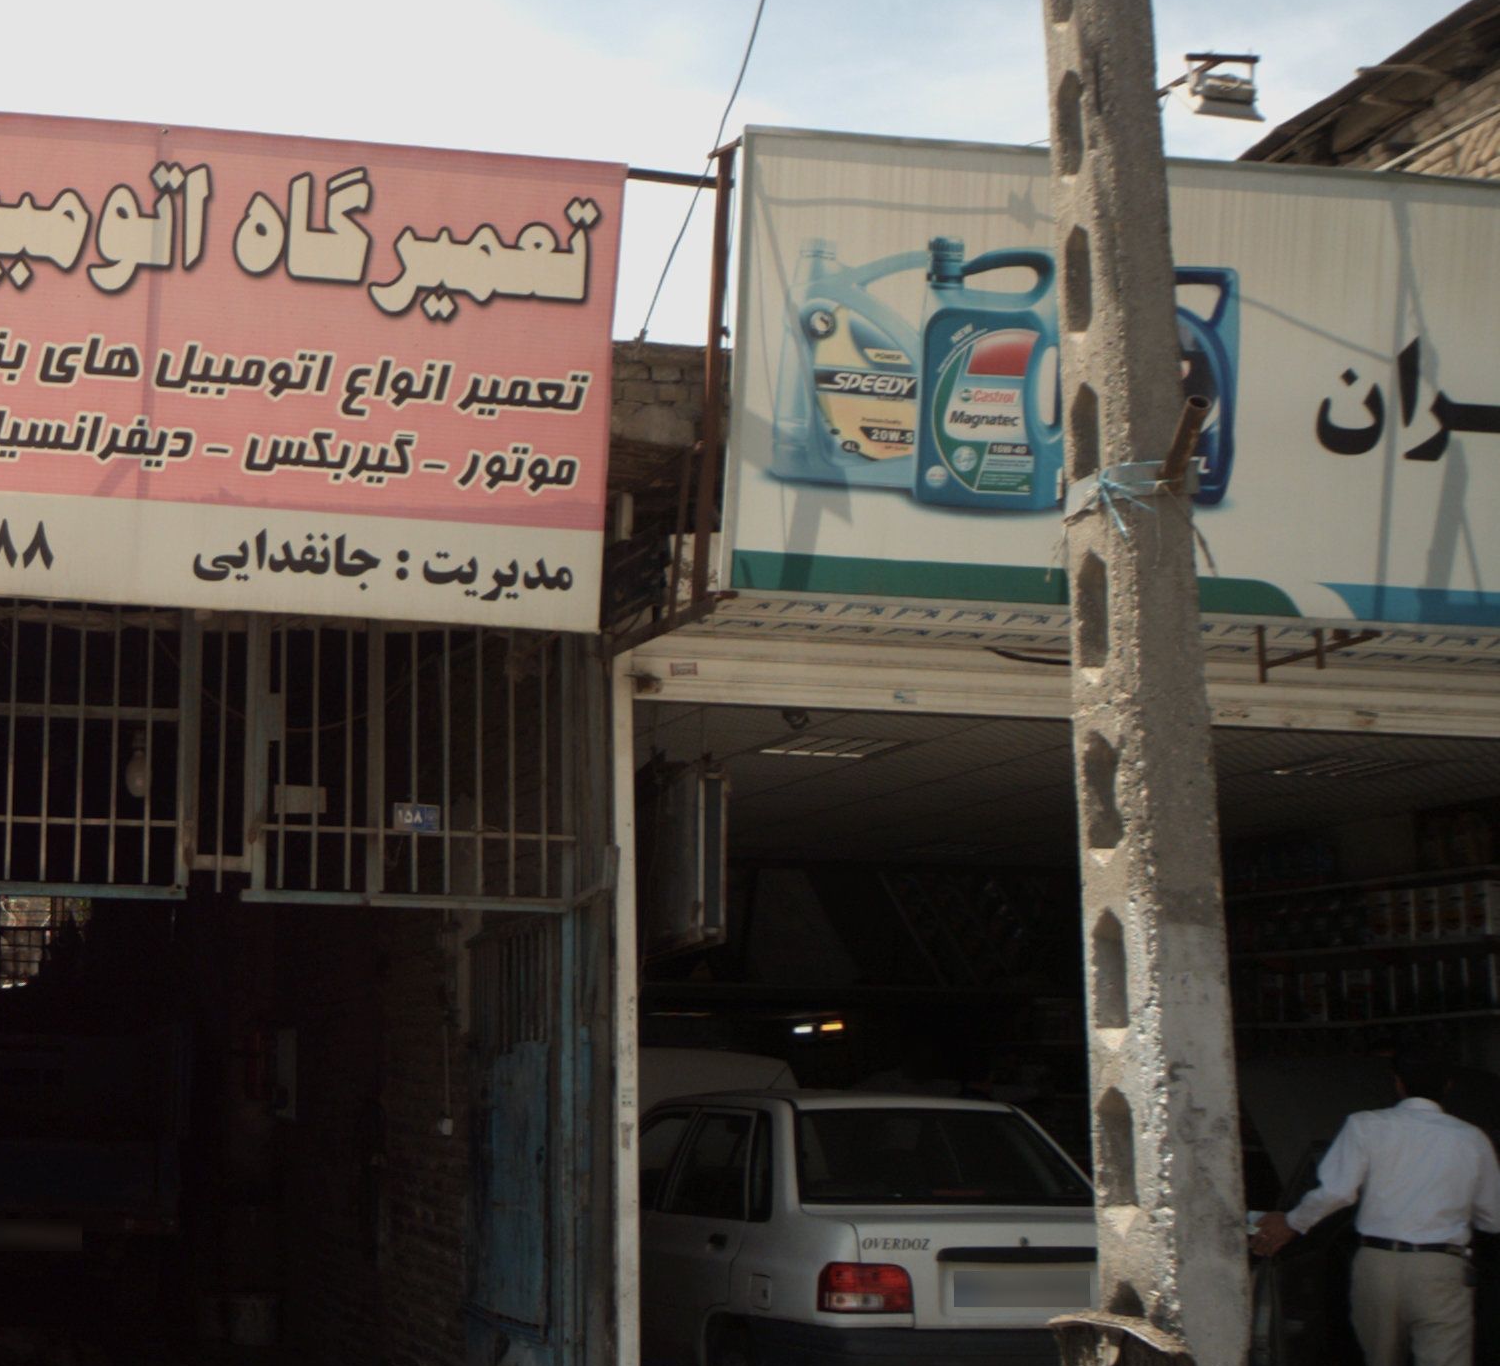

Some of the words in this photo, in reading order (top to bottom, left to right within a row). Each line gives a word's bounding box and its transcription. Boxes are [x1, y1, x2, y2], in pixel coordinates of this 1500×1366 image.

[40, 337, 140, 383] های
[155, 344, 333, 397] اتومبیل
[341, 359, 452, 417] انواع
[457, 373, 590, 417] تعمیر
[827, 371, 918, 396] SPEEDY
[973, 389, 1017, 404] Castrol
[1316, 335, 1500, 462] ران
[950, 410, 1021, 429] Magnatec
[245, 431, 416, 484] گیربکس
[457, 446, 578, 492] موتور
[193, 528, 382, 592] جانفدایی
[422, 548, 574, 602] مدیریت
[861, 1236, 932, 1251] OVERDOZ
